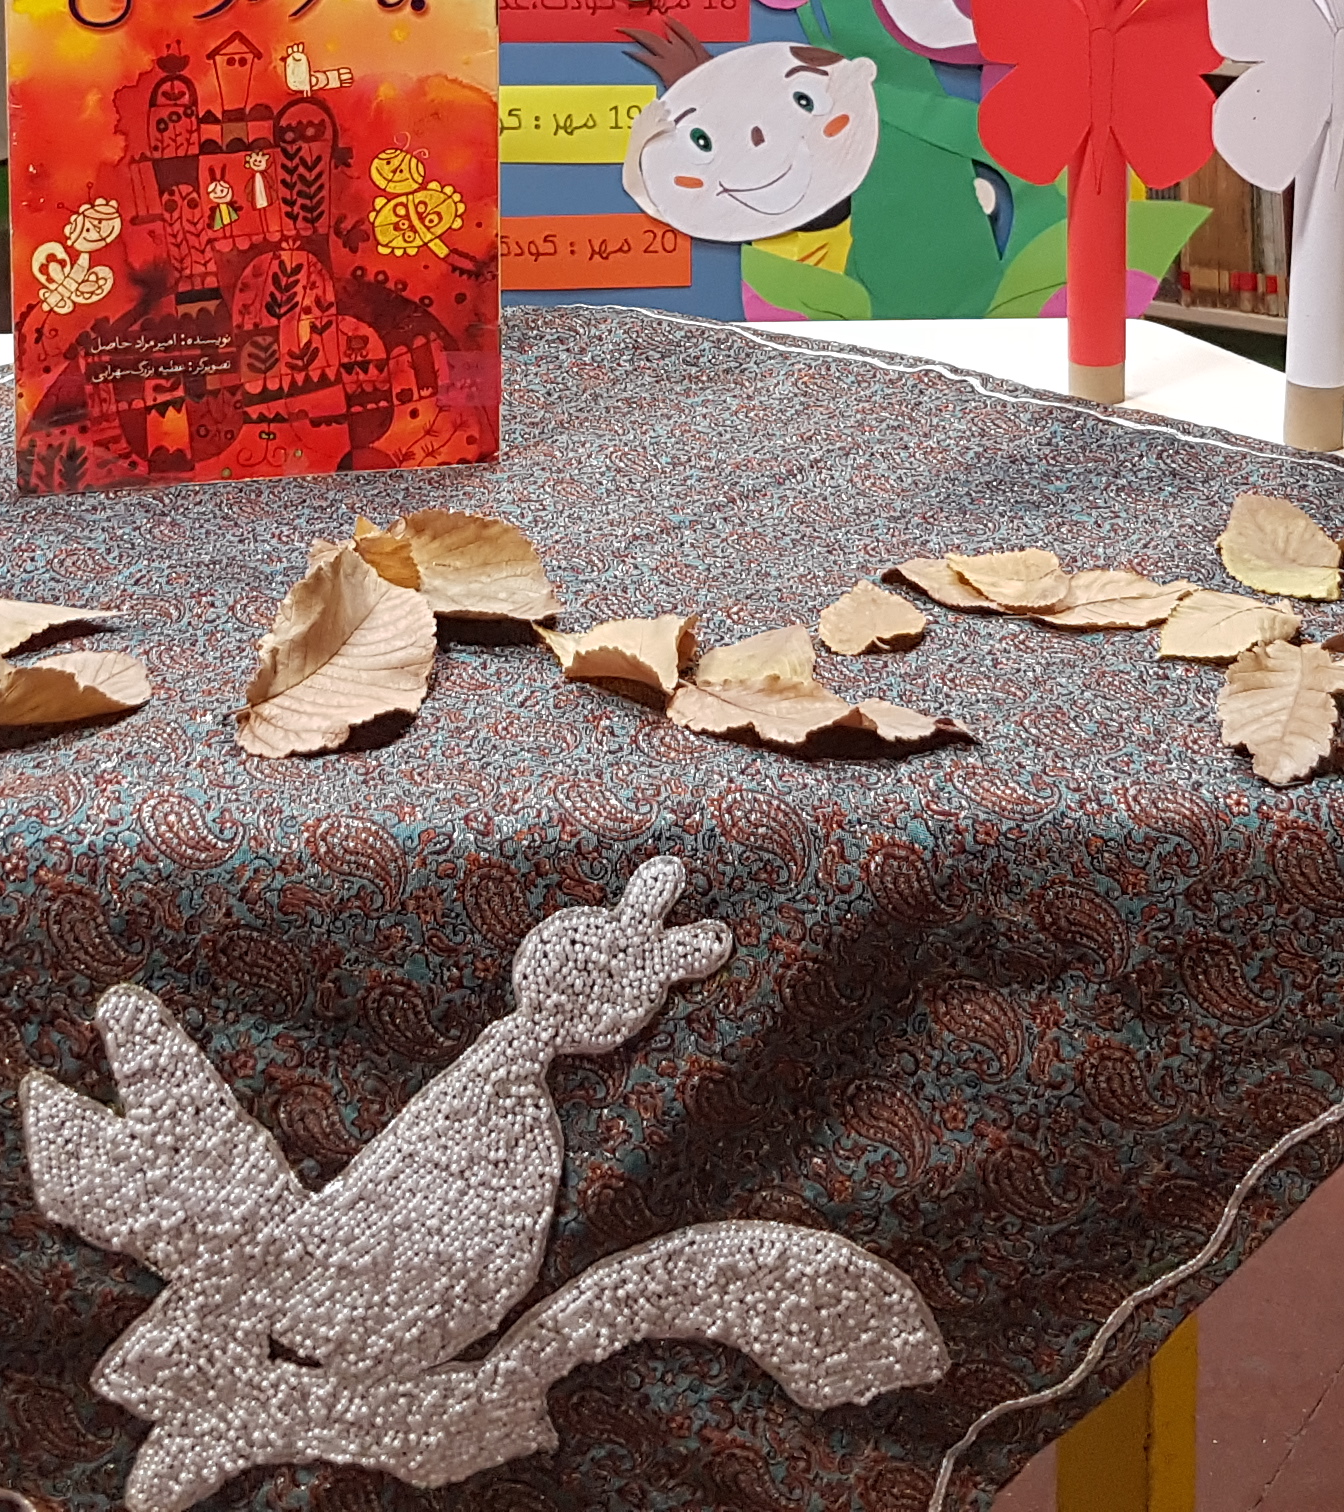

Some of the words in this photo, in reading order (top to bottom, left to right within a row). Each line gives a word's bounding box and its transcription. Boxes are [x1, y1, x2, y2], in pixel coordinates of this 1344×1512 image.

[552, 113, 597, 137] مهر
[608, 104, 643, 130] 19
[587, 237, 631, 261] مهر
[642, 229, 678, 254] 20
